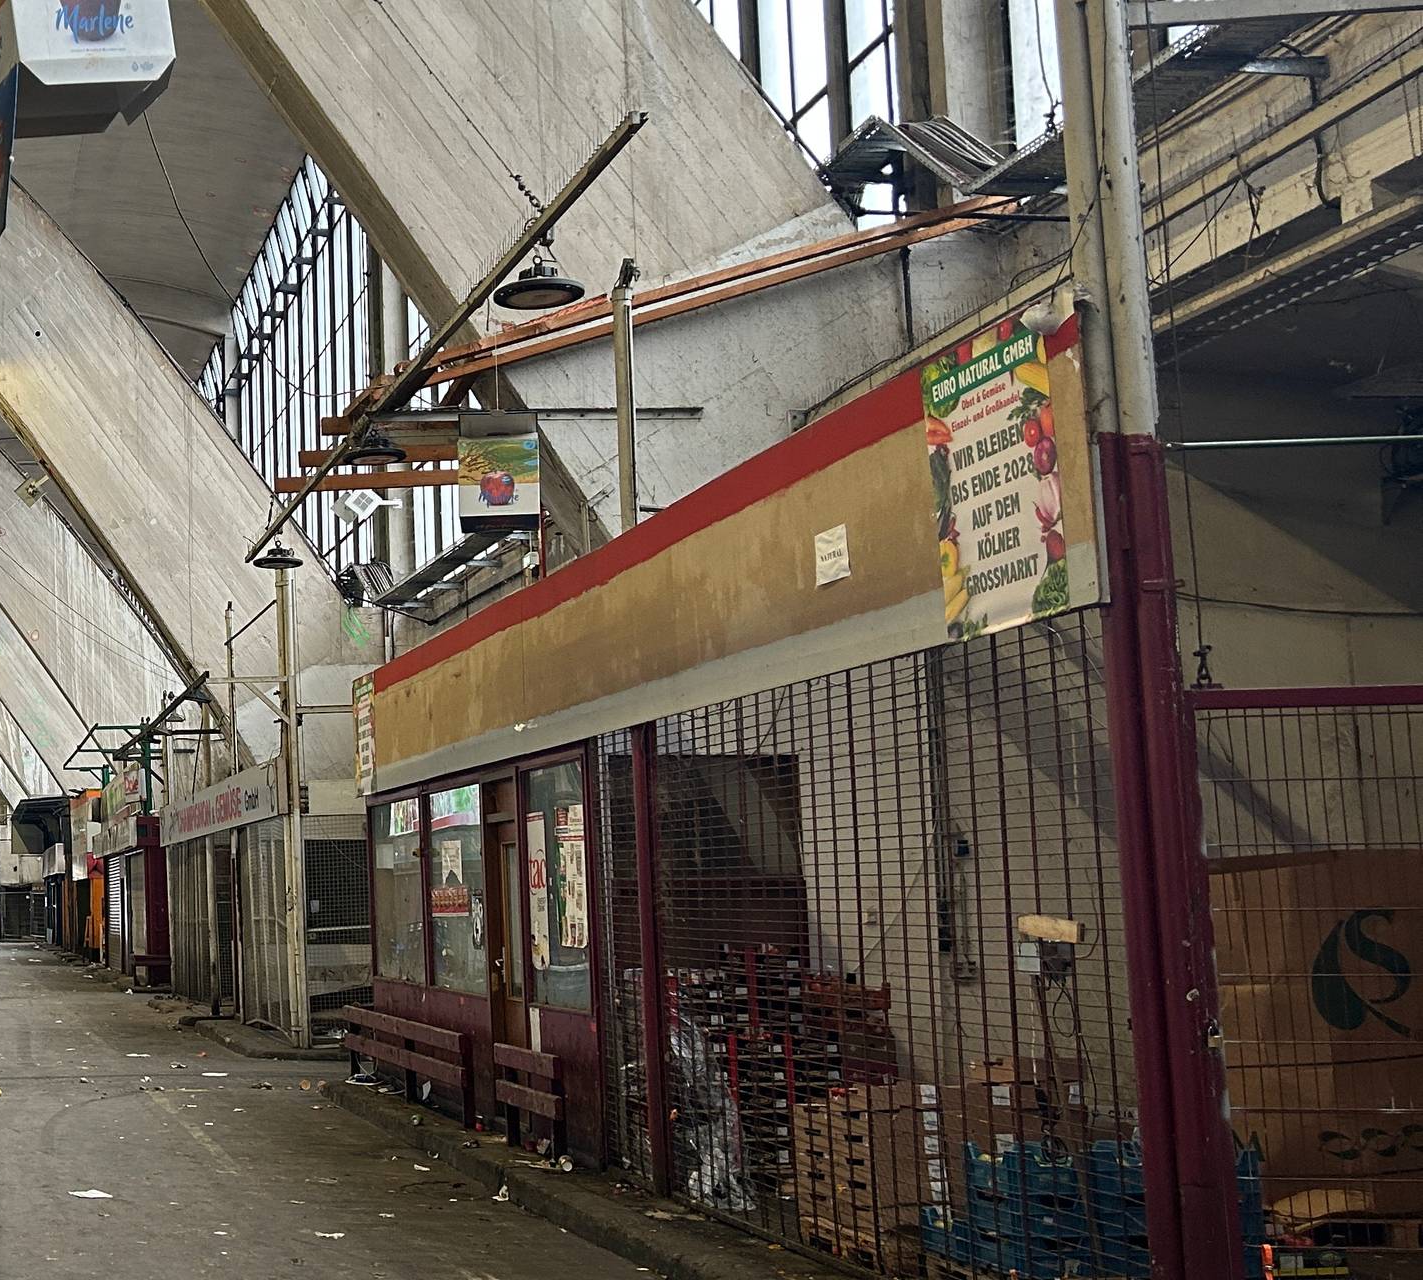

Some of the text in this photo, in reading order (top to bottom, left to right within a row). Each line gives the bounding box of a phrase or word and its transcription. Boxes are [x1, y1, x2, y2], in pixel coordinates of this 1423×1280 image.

[55, 3, 134, 44] Marlene
[932, 334, 1033, 402] EURO NATURAL GMBH
[961, 382, 1007, 410] Obst & Gemüse
[973, 409, 984, 422] und
[986, 390, 1020, 416] Großhandel
[953, 422, 1025, 471] WIR BLEIBEN
[951, 452, 1035, 506] BIS ENDE 2028
[972, 492, 1021, 531] AUF DEM
[977, 526, 1021, 561] KÖLNER
[965, 553, 1039, 598] GROSSMARKT
